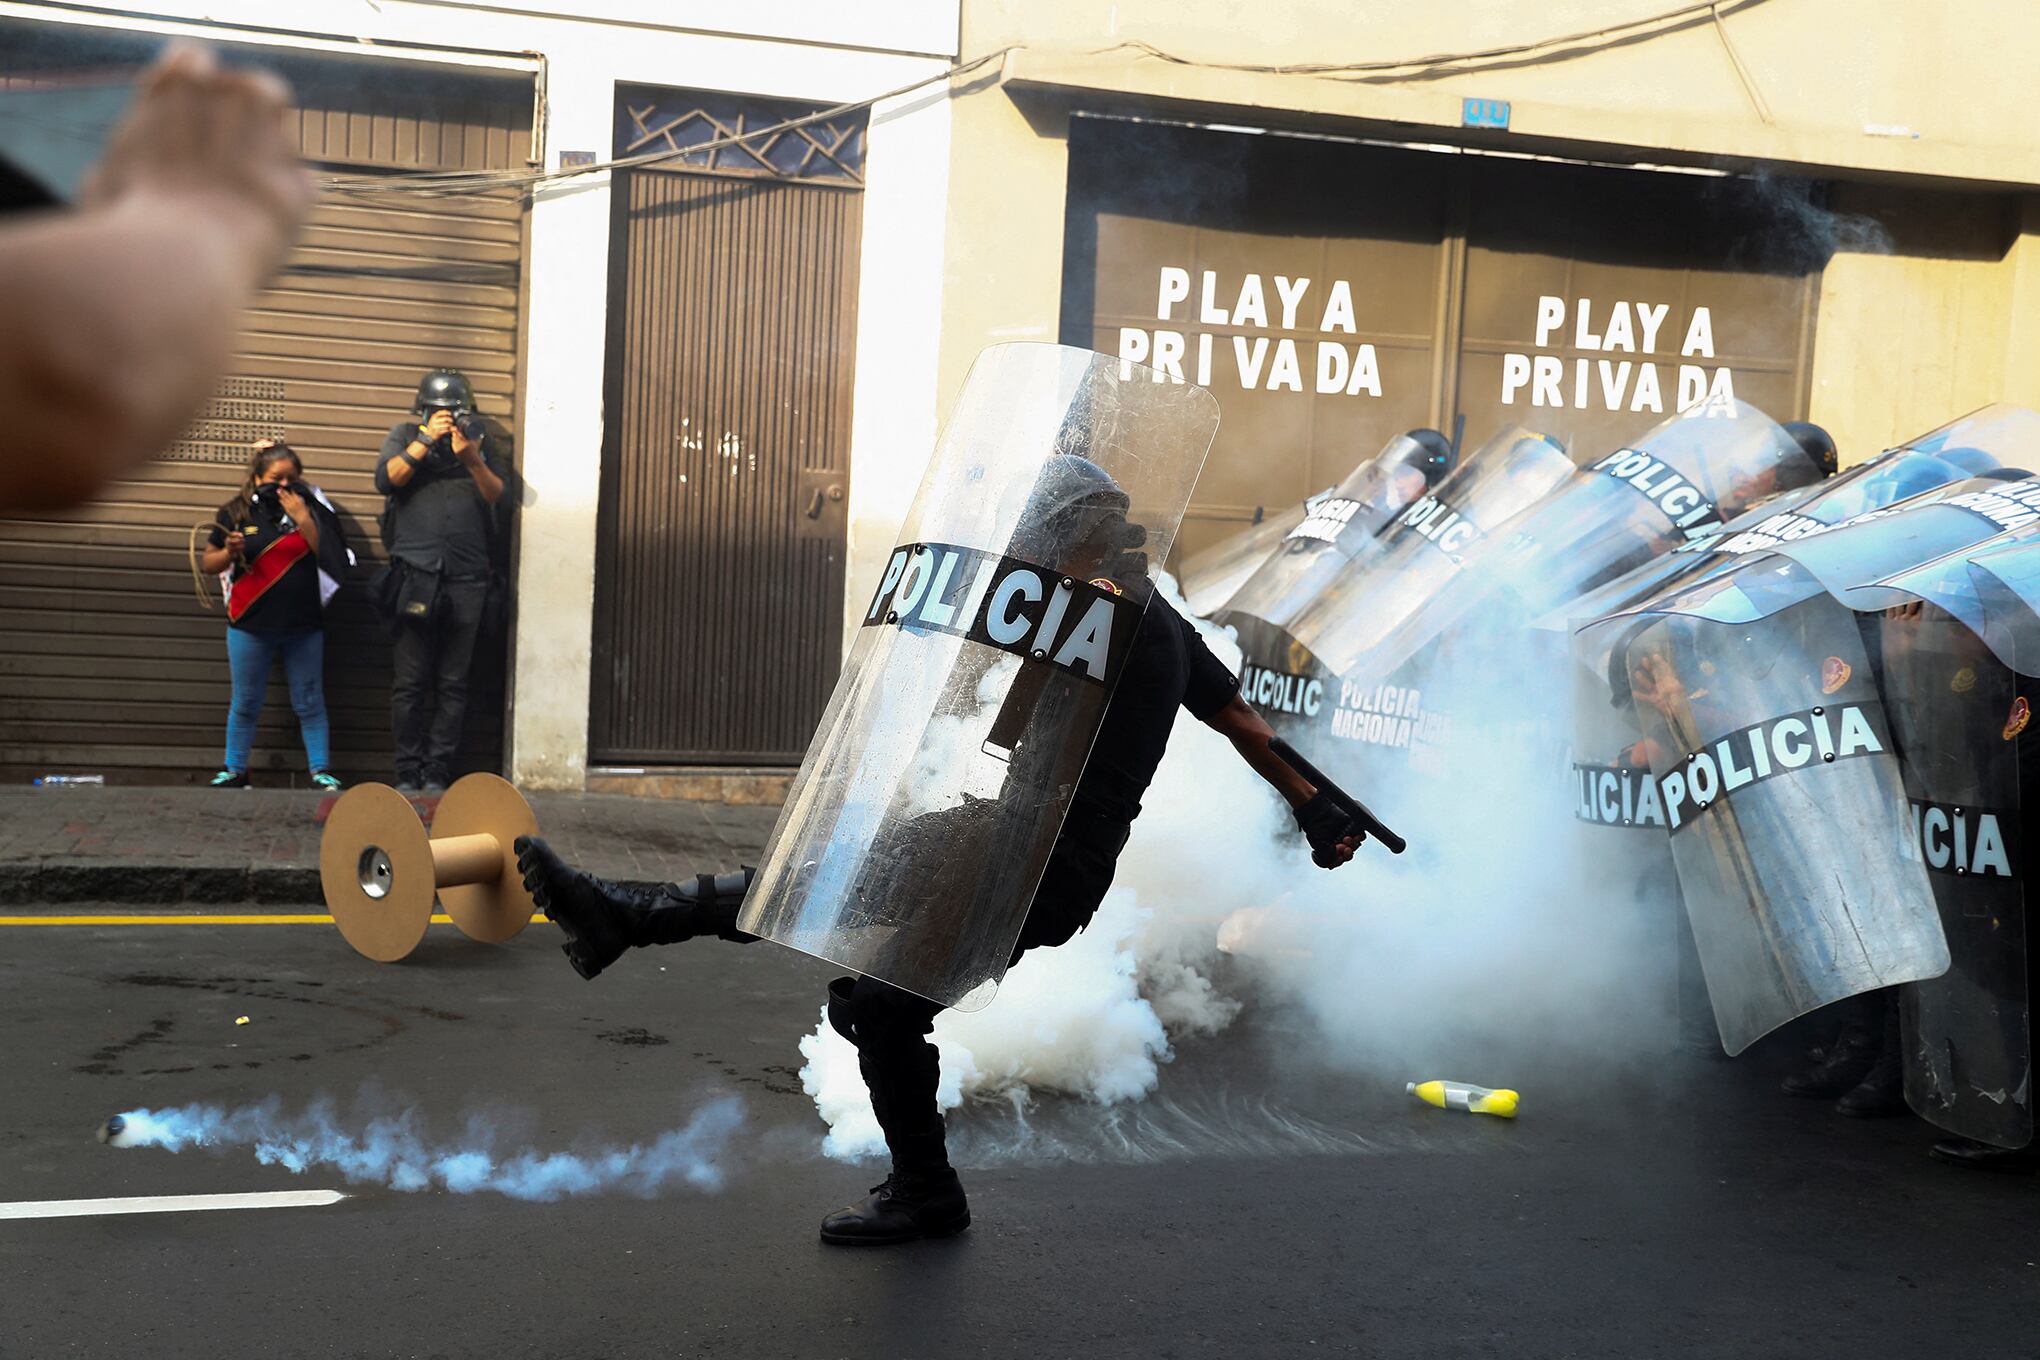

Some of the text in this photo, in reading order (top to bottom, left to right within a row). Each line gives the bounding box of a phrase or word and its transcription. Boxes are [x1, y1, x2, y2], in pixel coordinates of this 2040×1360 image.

[1157, 266, 1357, 334] PLAYA
[1535, 295, 1715, 358] PLAYA
[1118, 327, 1382, 397] PRIVADA
[869, 551, 1116, 682] POLICIA
[1271, 671, 1323, 718] OLIC
[1331, 708, 1412, 748] NACIONA
[1577, 768, 1665, 825] LICIA
[1661, 706, 1883, 829] POLICIA
